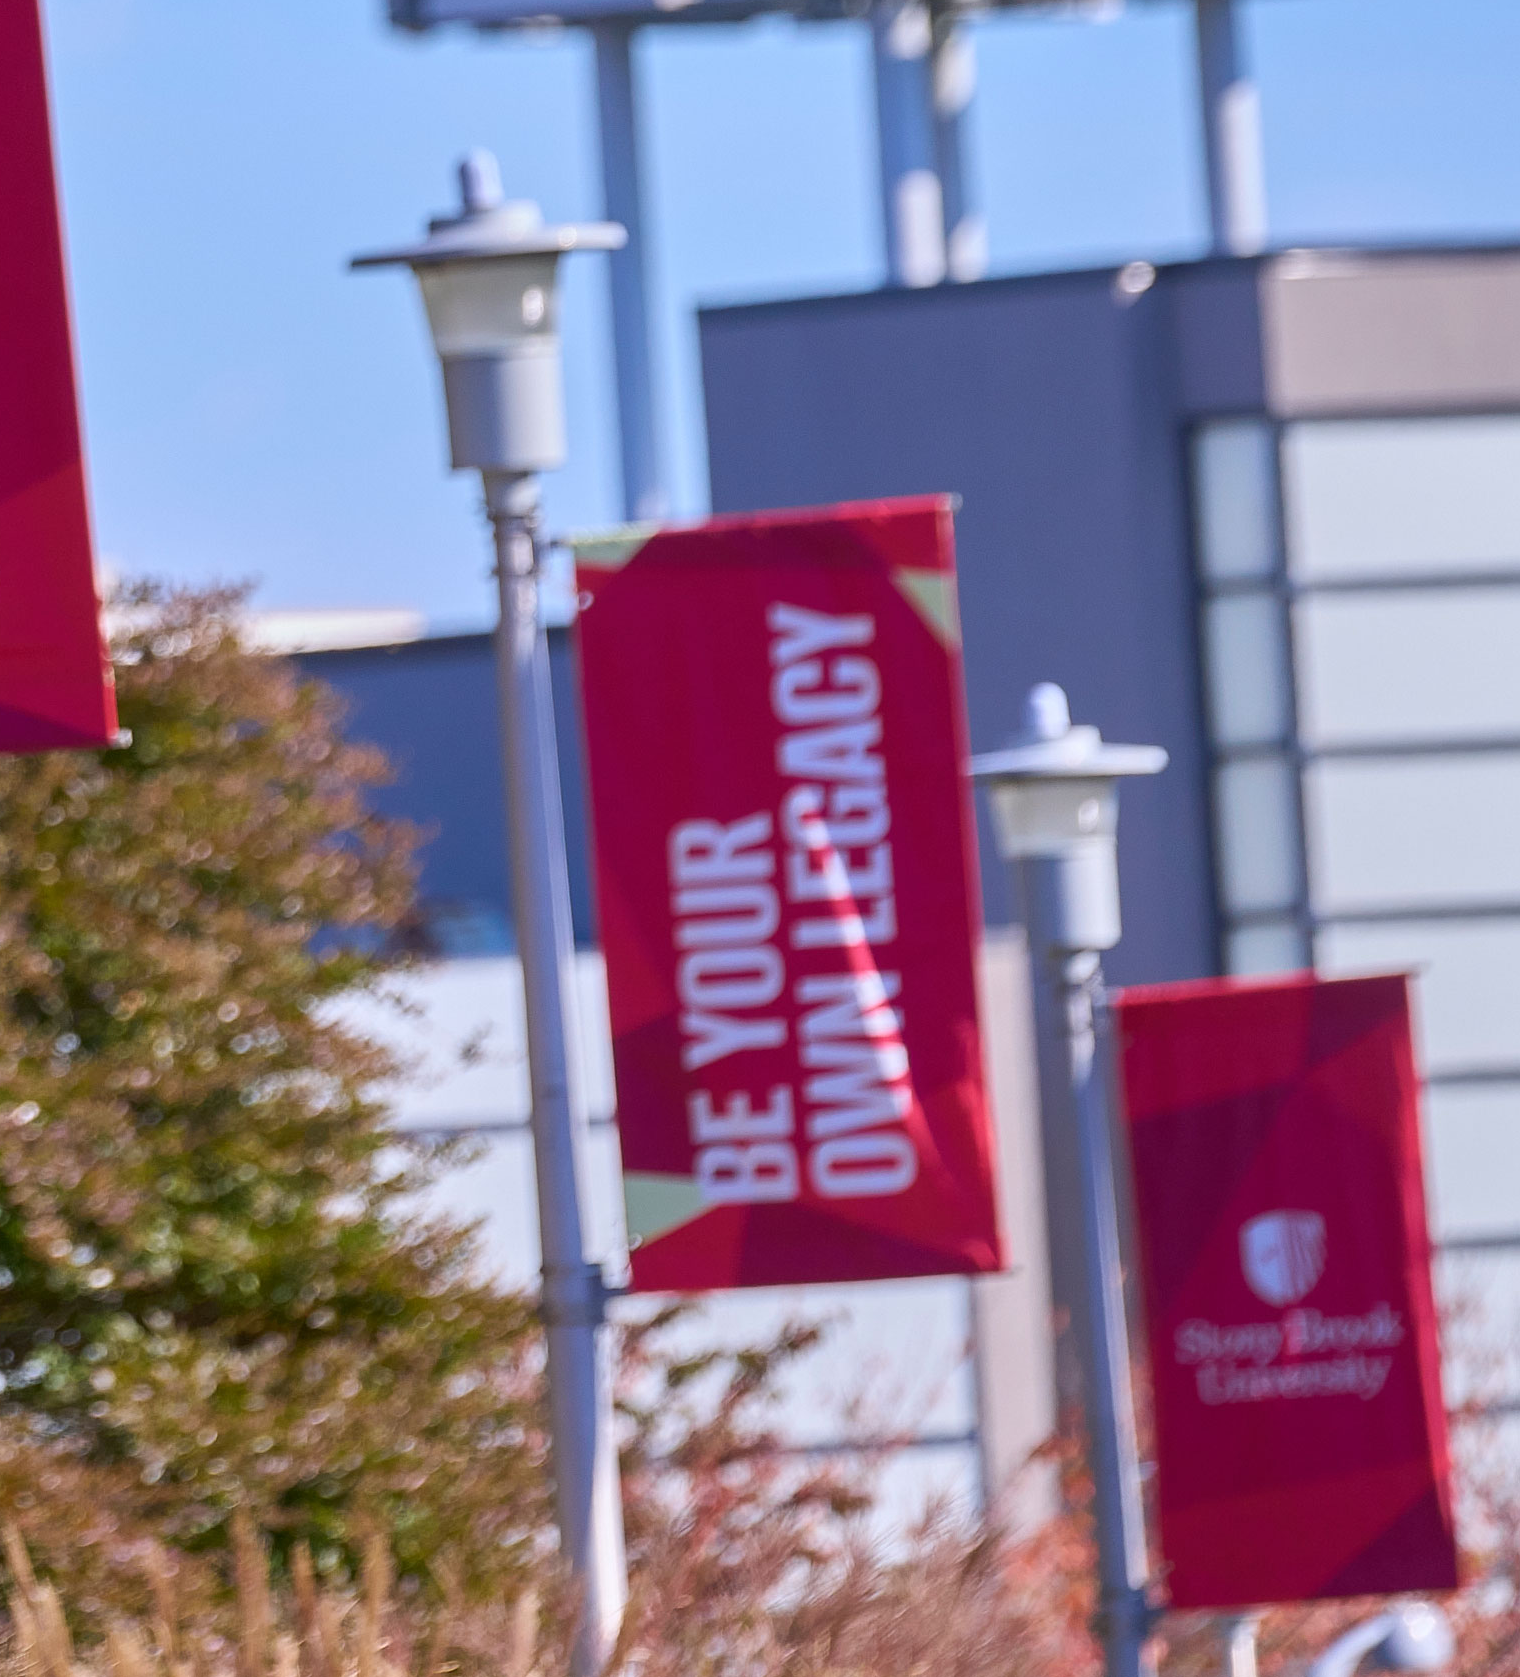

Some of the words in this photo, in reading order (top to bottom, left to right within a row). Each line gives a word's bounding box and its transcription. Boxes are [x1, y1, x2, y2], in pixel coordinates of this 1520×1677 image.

[769, 600, 900, 948] LEGACY
[669, 811, 788, 1070] YOUR
[688, 1084, 801, 1206] BE
[795, 971, 918, 1199] OWN
